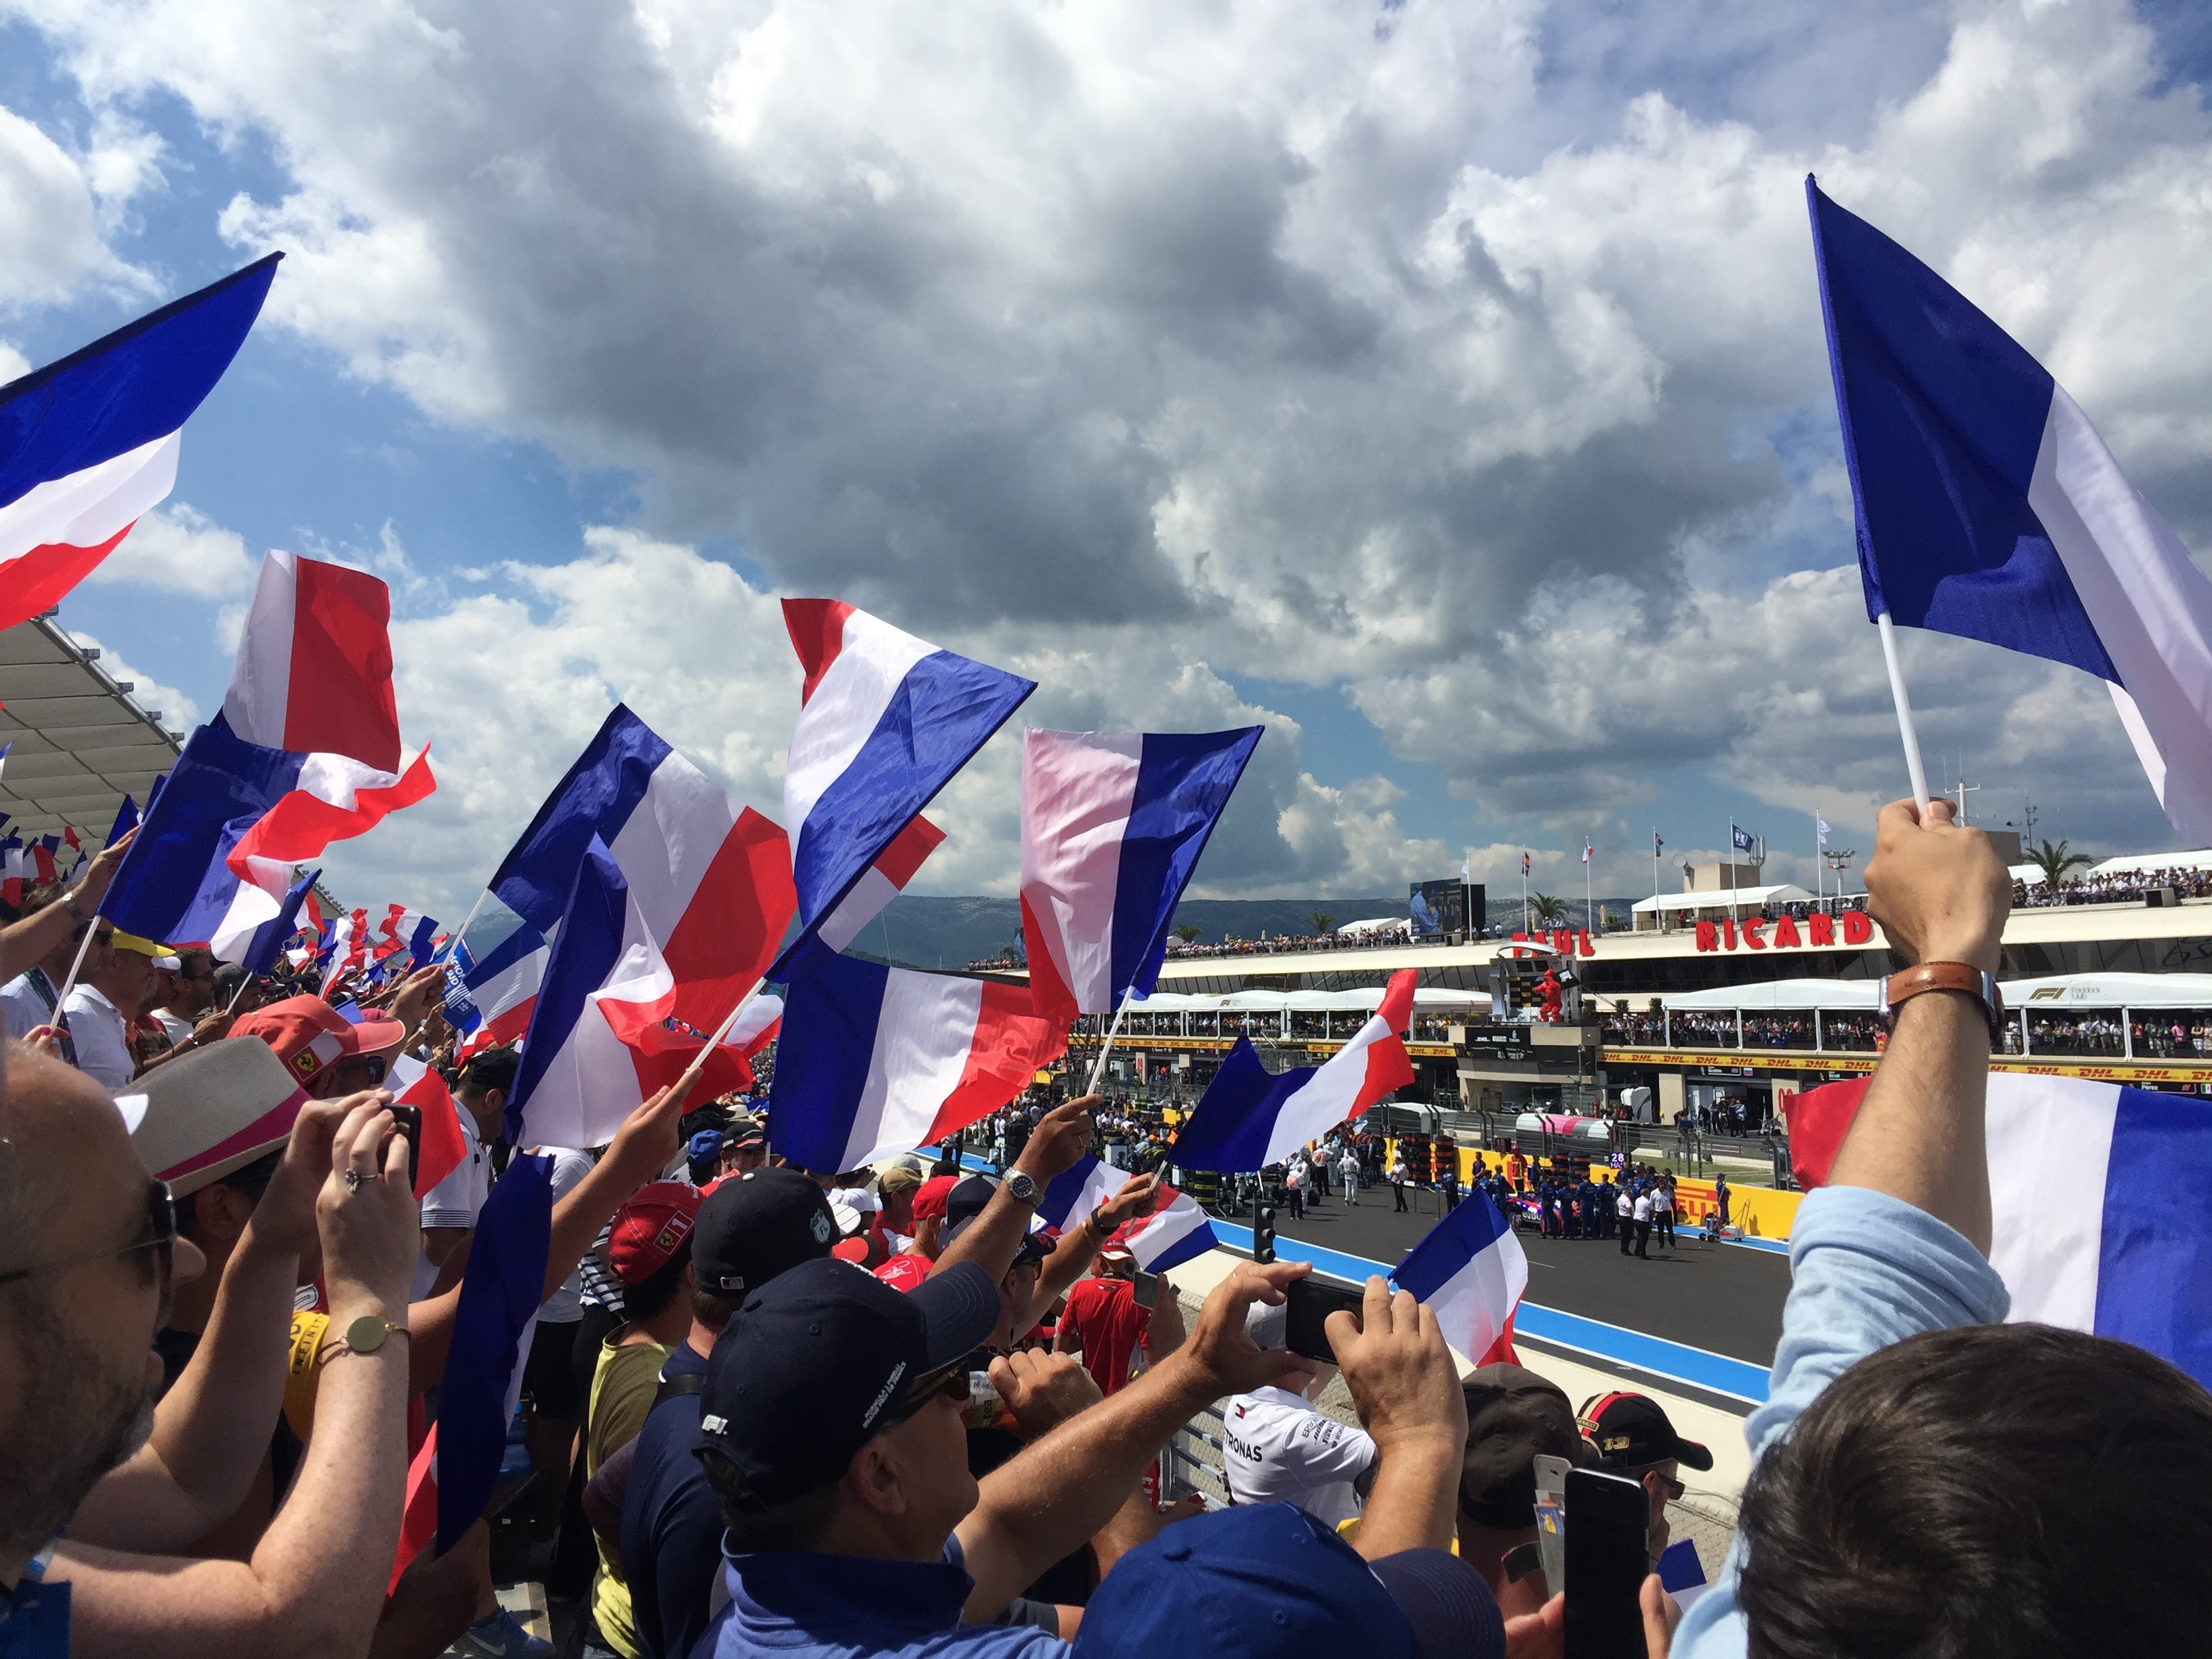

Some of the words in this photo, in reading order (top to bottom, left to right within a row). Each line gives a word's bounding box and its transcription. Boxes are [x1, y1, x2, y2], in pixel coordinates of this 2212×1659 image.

[1511, 928, 1595, 958] PAUL
[1694, 910, 1874, 953] RICARD
[2028, 987, 2067, 1000] F1
[1663, 1055, 1685, 1063] DHL
[1730, 1058, 1755, 1066] DHL
[1767, 1059, 1792, 1067] DHL
[1805, 1060, 1831, 1069] DHL
[1844, 1061, 1872, 1070] DHL
[2026, 1066, 2062, 1076] DHL
[2078, 1068, 2115, 1078] DHL
[2133, 1069, 2172, 1080] DHL
[1611, 1153, 1624, 1162] 28
[672, 1217, 689, 1230] 1
[862, 1406, 880, 1429] GRAND
[893, 1361, 907, 1385] FRANCE
[865, 1389, 885, 1418] FORMULA
[701, 1414, 729, 1435] F1
[1224, 1427, 1263, 1462] TRONAS
[1603, 1436, 1630, 1450] 13
